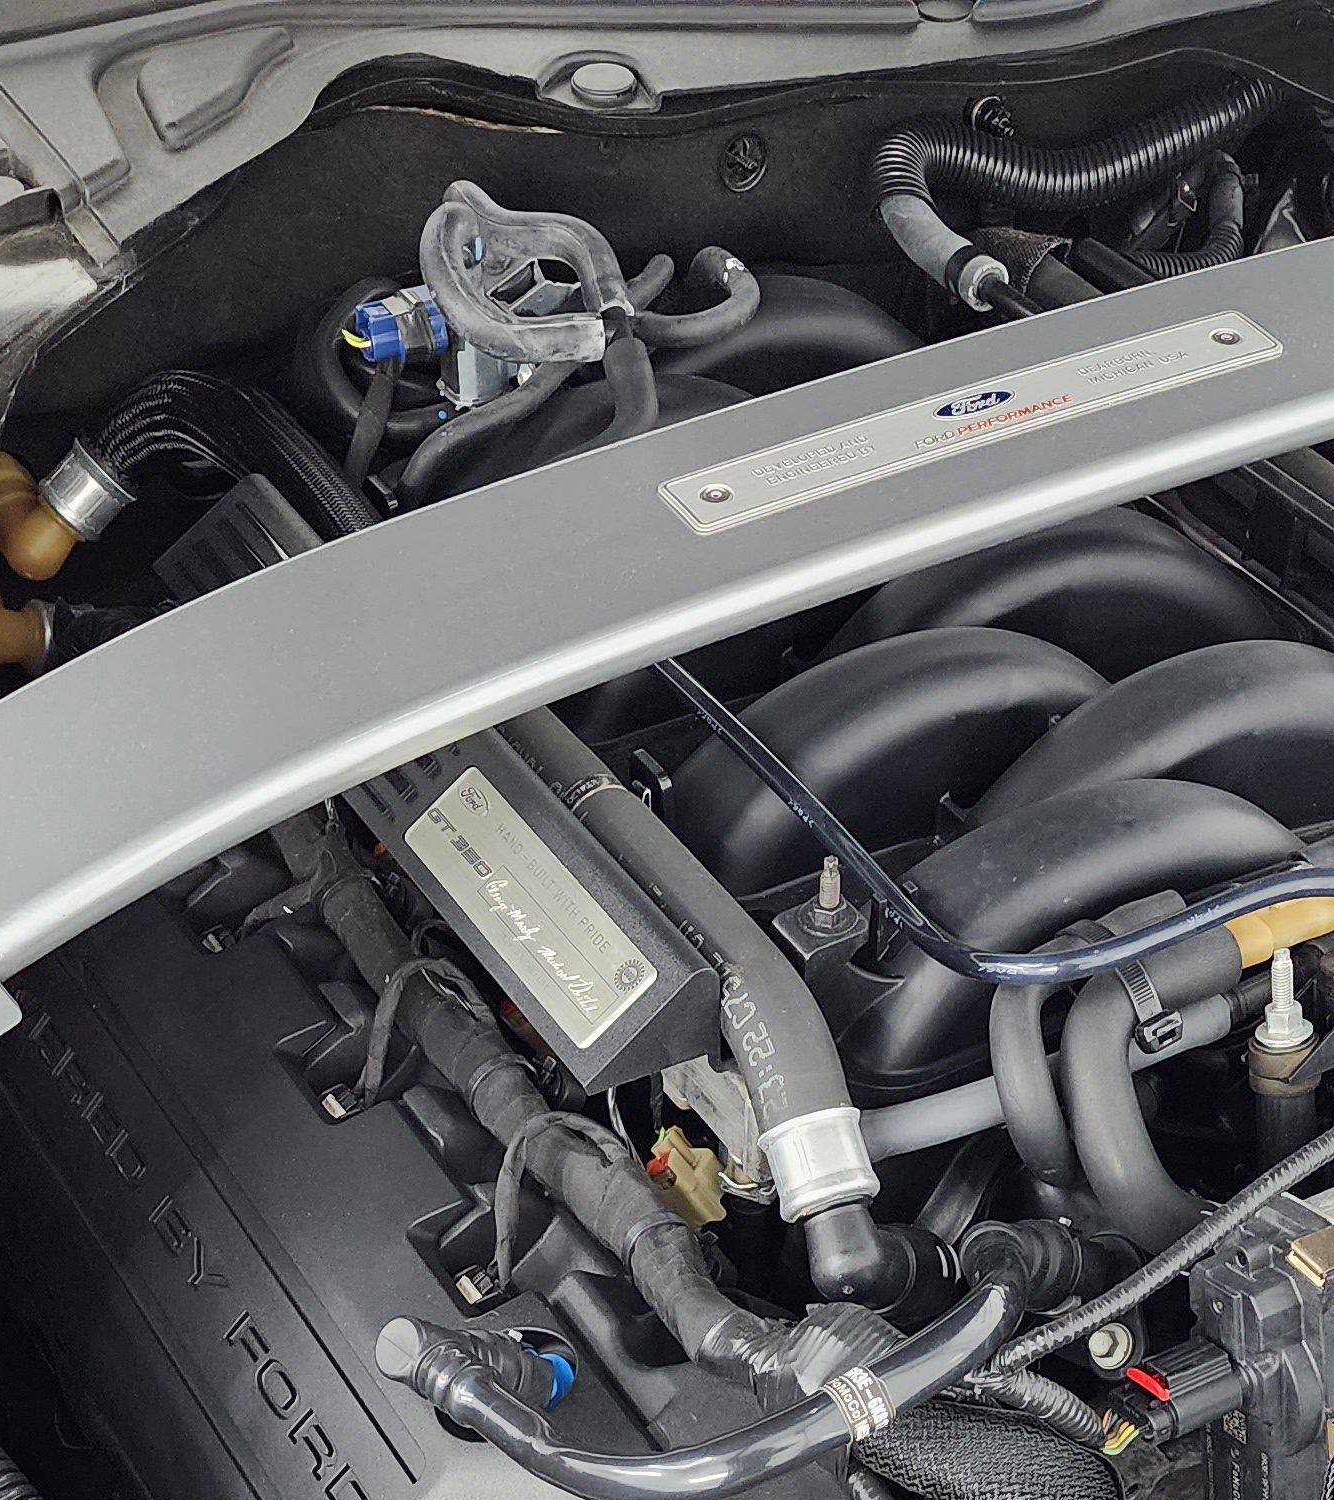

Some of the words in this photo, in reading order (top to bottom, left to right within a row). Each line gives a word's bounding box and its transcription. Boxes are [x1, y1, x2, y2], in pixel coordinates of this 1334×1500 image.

[1085, 357, 1155, 386] MICHIGAN
[1157, 348, 1189, 366] USA
[913, 427, 955, 450] FORD
[956, 391, 1073, 437] PERFORMANCE
[948, 389, 1001, 418] Ford
[751, 443, 836, 478] DEVELOPED
[837, 432, 869, 450] AND
[765, 449, 856, 488] ENGINEERED
[855, 442, 878, 458] BY
[458, 783, 486, 813] Ford
[551, 888, 581, 921] WITH
[575, 915, 612, 955] PRIDE
[144, 1192, 231, 1294] BY
[826, 1377, 861, 1420] FoMoCo
